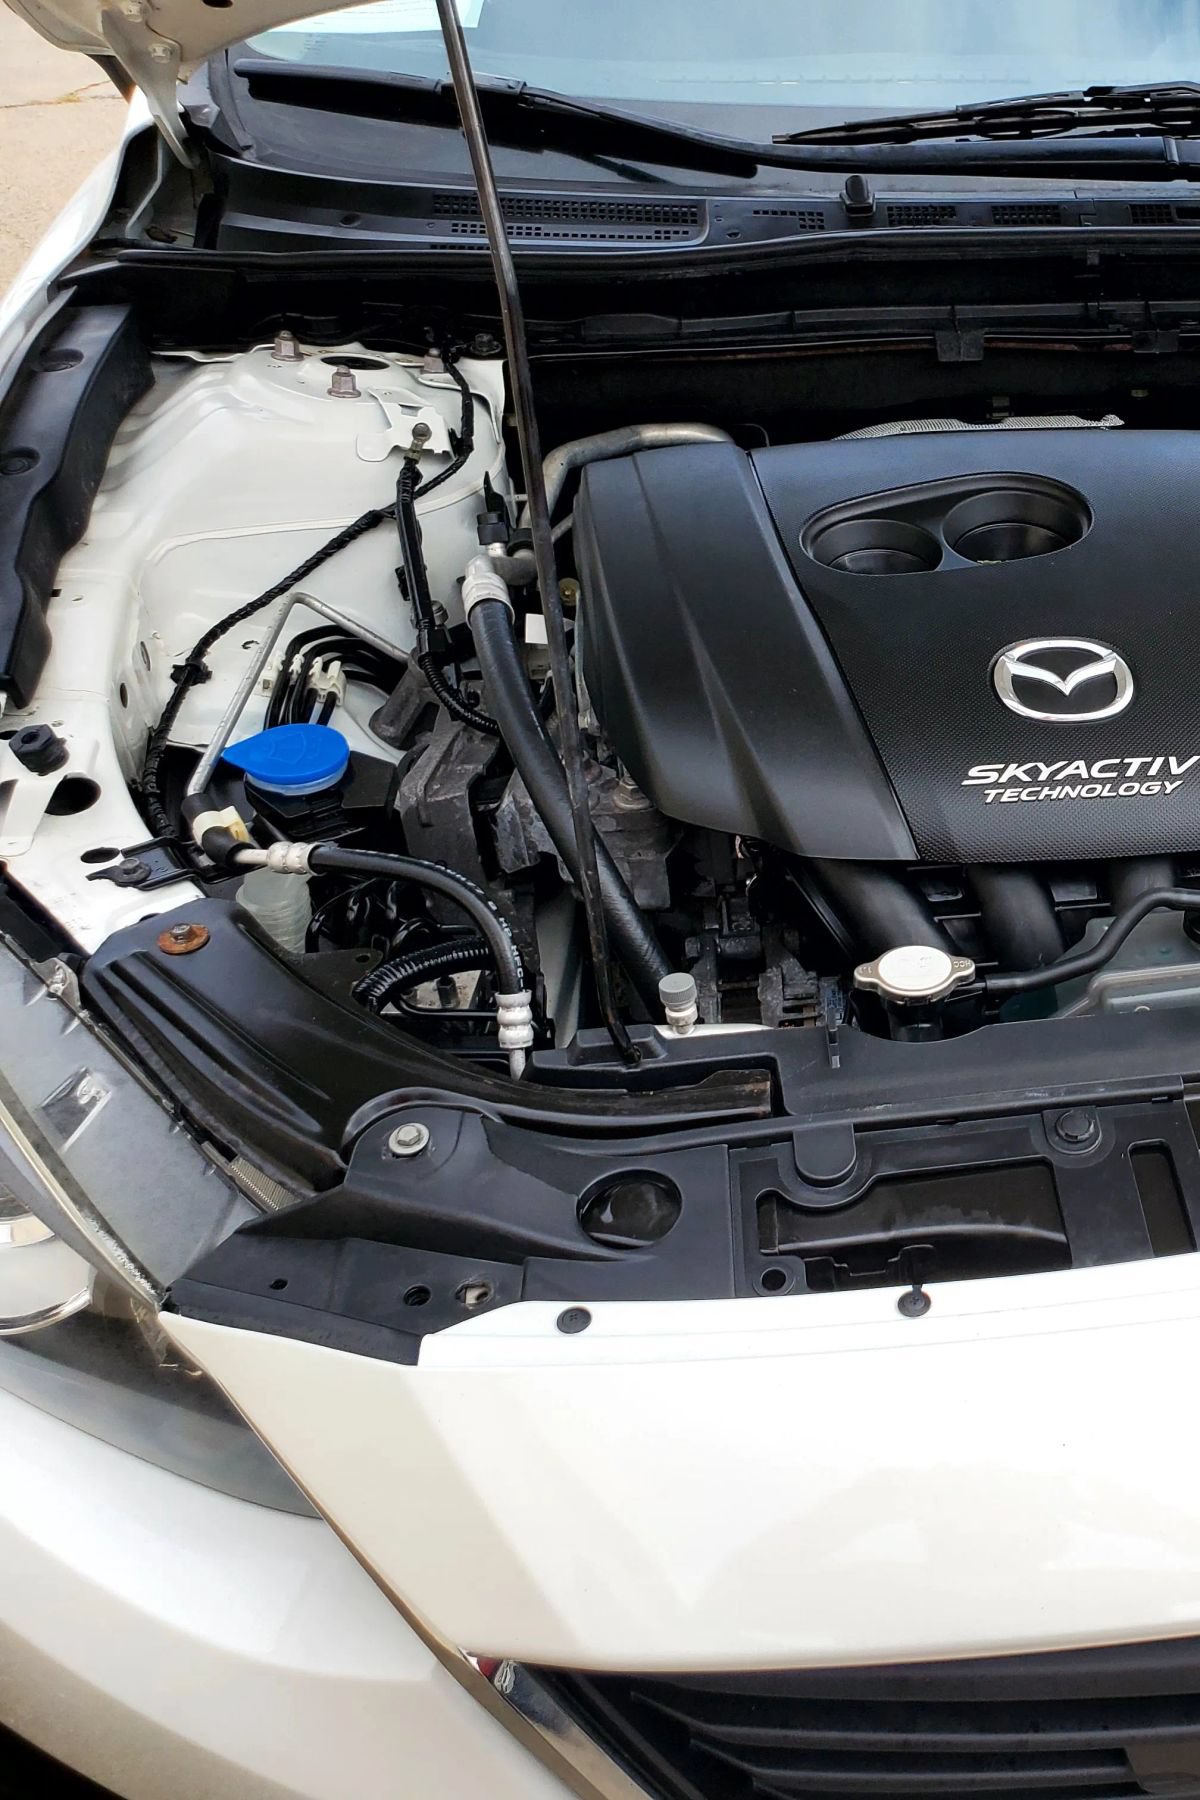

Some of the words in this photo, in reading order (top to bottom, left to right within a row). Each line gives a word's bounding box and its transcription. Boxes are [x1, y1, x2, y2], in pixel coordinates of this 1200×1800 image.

[961, 755, 1200, 786] SKYACTIV
[983, 780, 1184, 804] TECHNOLOGY
[511, 945, 525, 993] HFC-
